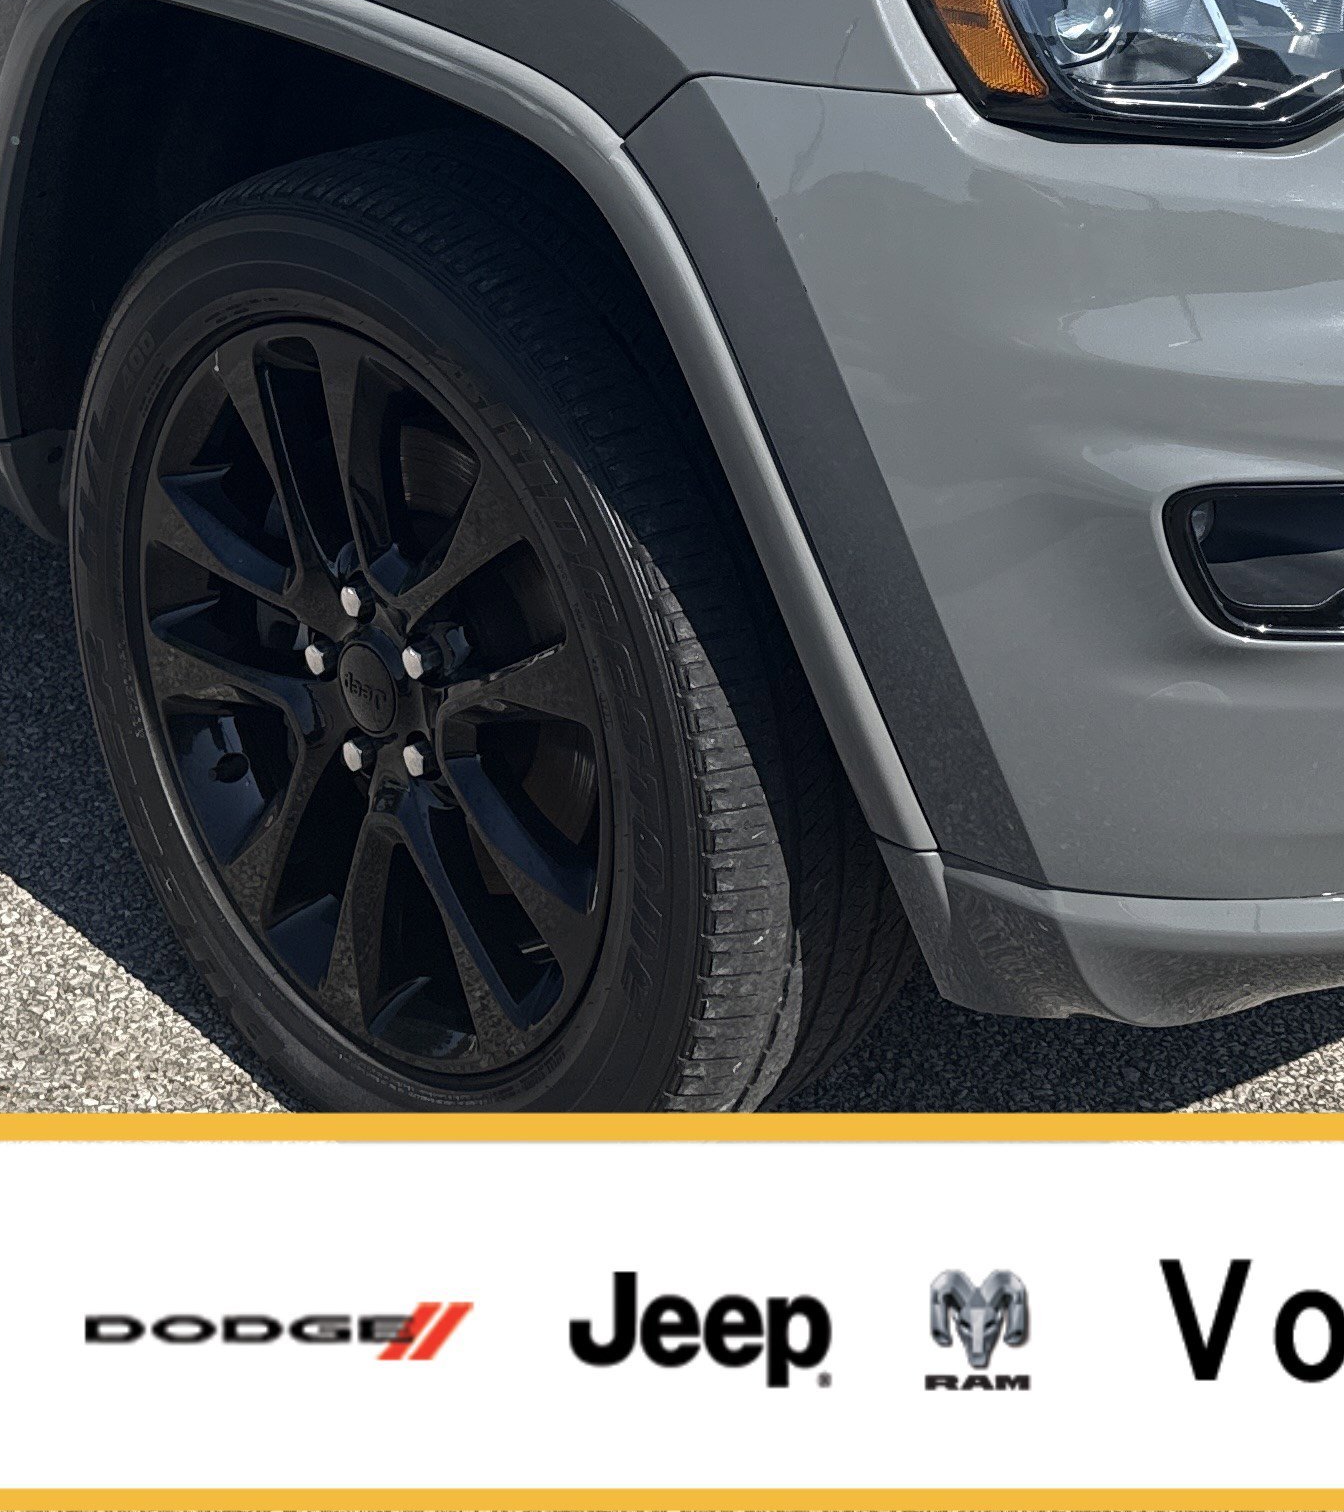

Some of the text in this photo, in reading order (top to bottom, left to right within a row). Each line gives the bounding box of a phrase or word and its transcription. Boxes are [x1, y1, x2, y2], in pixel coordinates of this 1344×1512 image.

[80, 624, 283, 1071] DUELER
[344, 672, 387, 710] Jeep
[429, 344, 663, 1010] BRIDGESTONE
